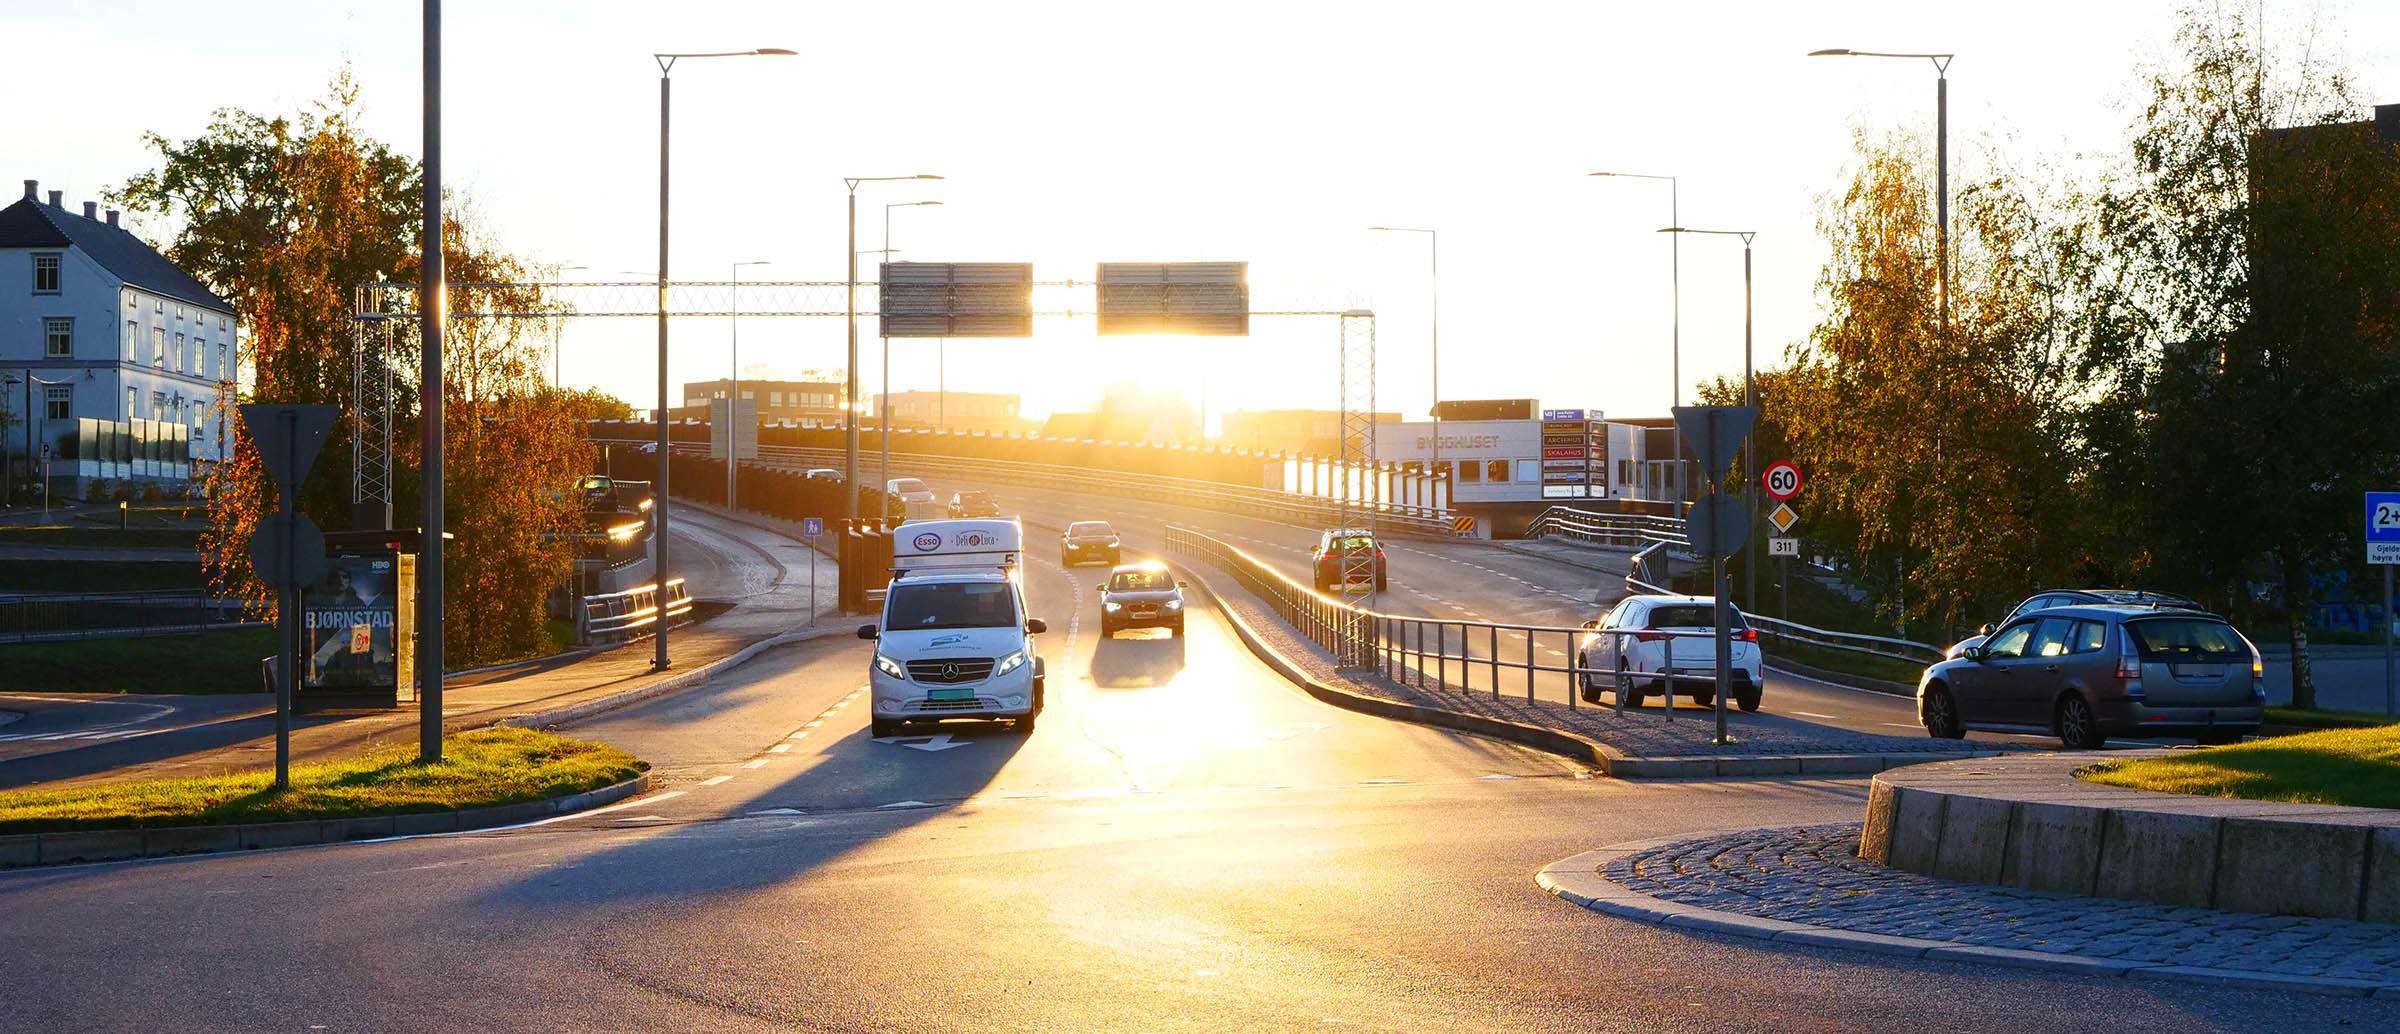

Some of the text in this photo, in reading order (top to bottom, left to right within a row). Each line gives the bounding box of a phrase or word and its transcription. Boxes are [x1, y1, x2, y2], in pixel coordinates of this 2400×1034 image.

[1416, 435, 1499, 449] BYGGHUSET
[1770, 471, 1796, 490] 60
[981, 534, 994, 545] Luca
[1776, 542, 1792, 552] 311
[372, 561, 390, 569] HBO
[1005, 554, 1015, 565] 5
[306, 612, 392, 628] BJØRNSTAD
